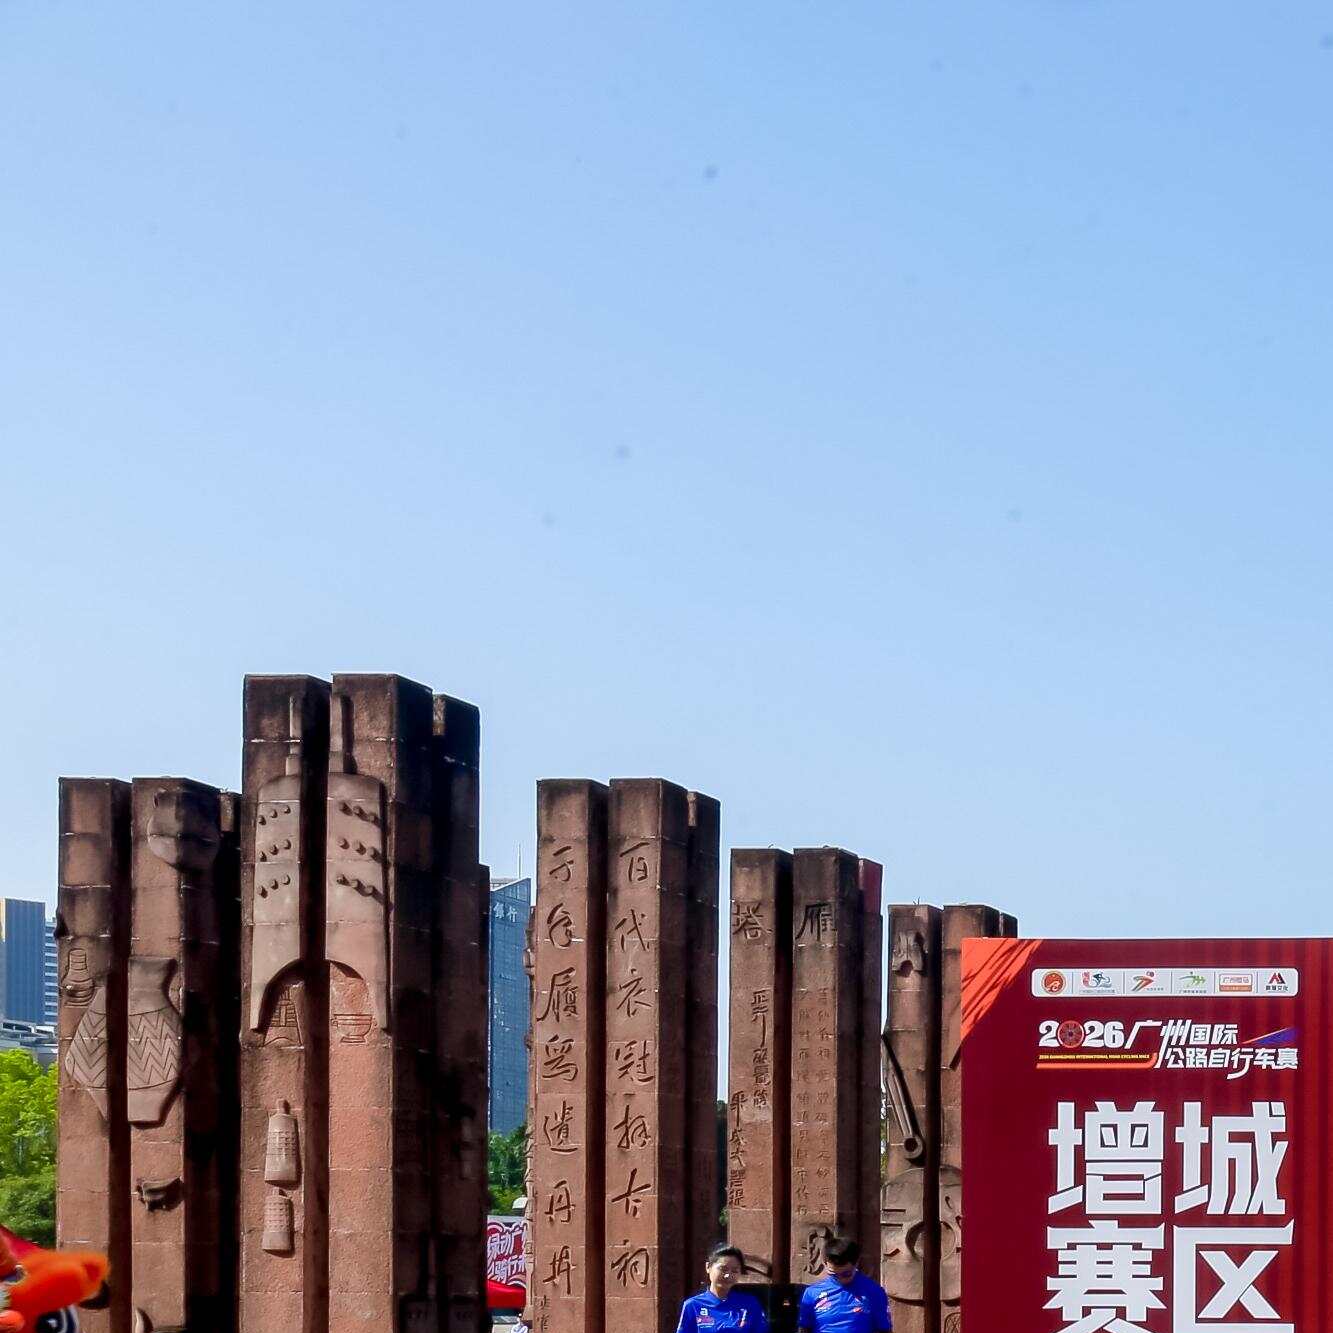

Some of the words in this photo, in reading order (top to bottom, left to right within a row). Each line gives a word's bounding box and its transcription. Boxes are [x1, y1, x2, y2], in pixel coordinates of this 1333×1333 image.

[1164, 1047, 1298, 1080] 公路自行车赛
[1047, 1100, 1289, 1215] 增城
